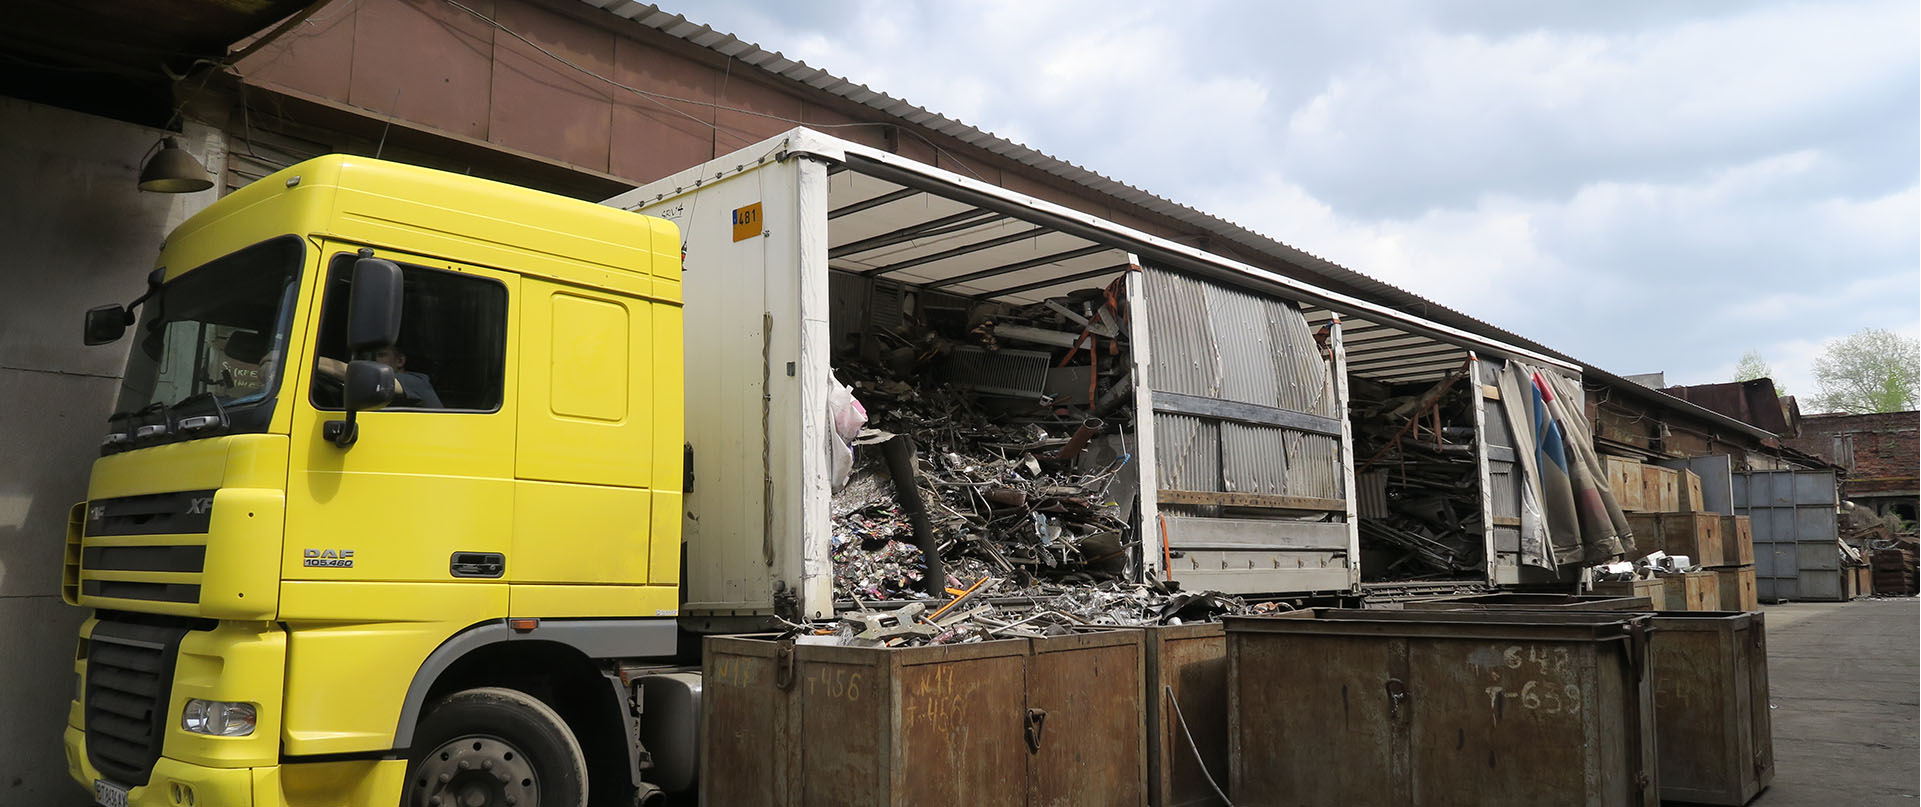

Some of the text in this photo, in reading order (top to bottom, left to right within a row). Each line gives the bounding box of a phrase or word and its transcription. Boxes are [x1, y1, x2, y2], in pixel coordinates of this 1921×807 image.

[739, 209, 756, 226] 481
[304, 549, 354, 559] DAF
[305, 559, 353, 567] 105.460
